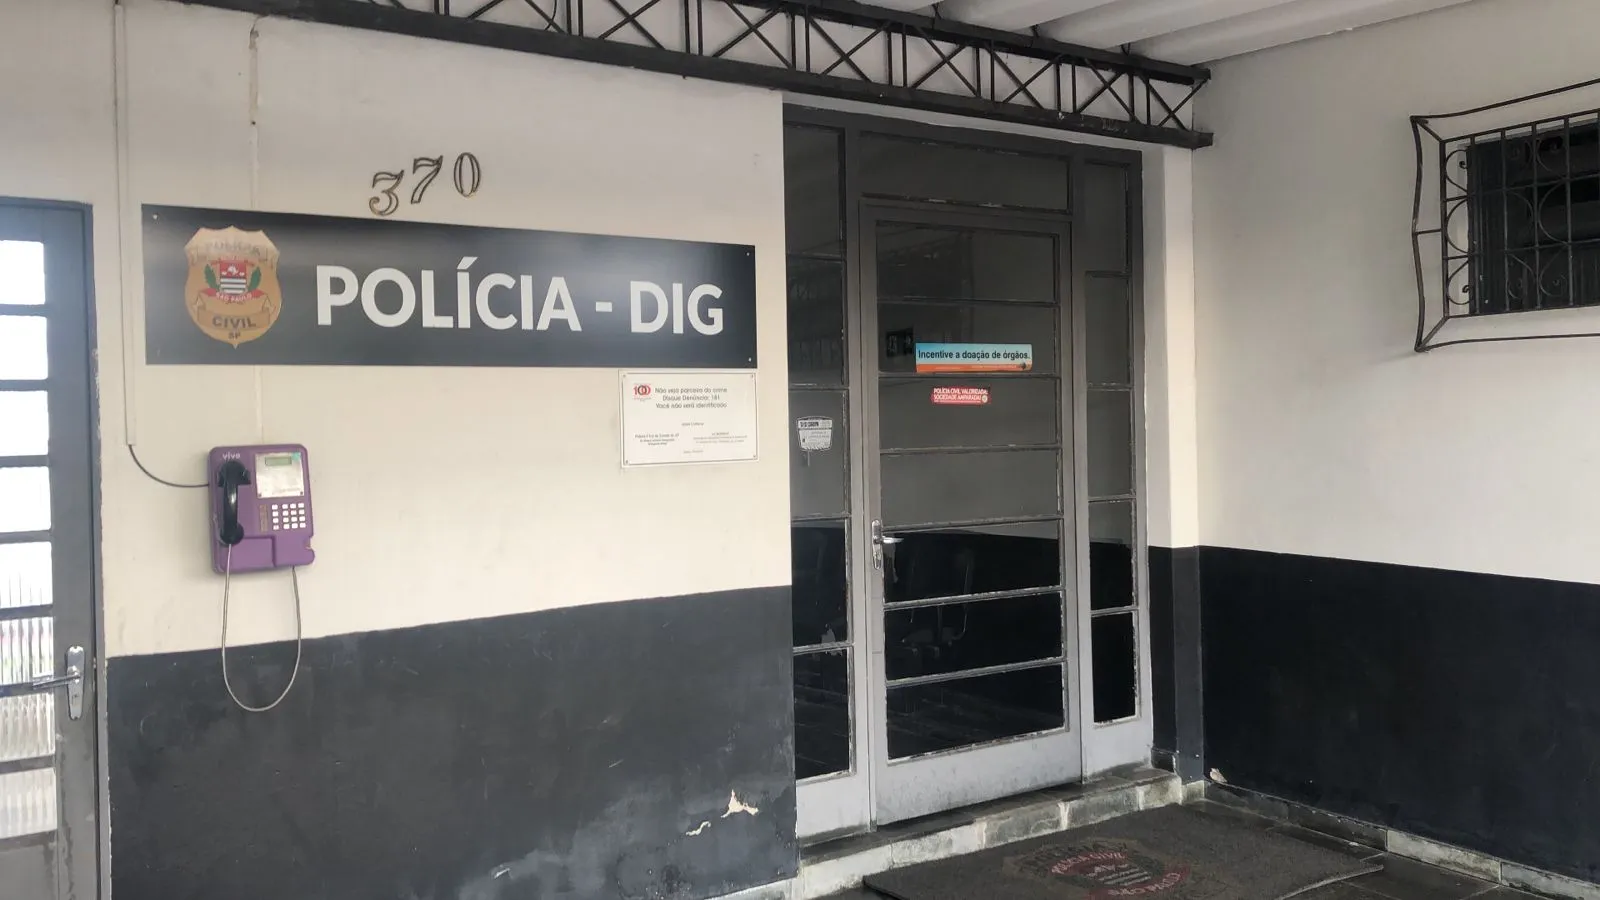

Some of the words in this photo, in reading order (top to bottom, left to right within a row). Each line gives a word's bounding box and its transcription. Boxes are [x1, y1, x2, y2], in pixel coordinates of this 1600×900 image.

[368, 152, 482, 217] 370
[316, 256, 582, 331] POLÍCIA
[595, 301, 613, 313] -
[629, 281, 724, 336] DIG
[212, 316, 257, 328] CIVIL
[228, 331, 241, 340] SP
[918, 350, 954, 359] Incentive
[961, 350, 990, 361] doação
[991, 350, 1002, 359] de
[222, 451, 241, 460] vivo
